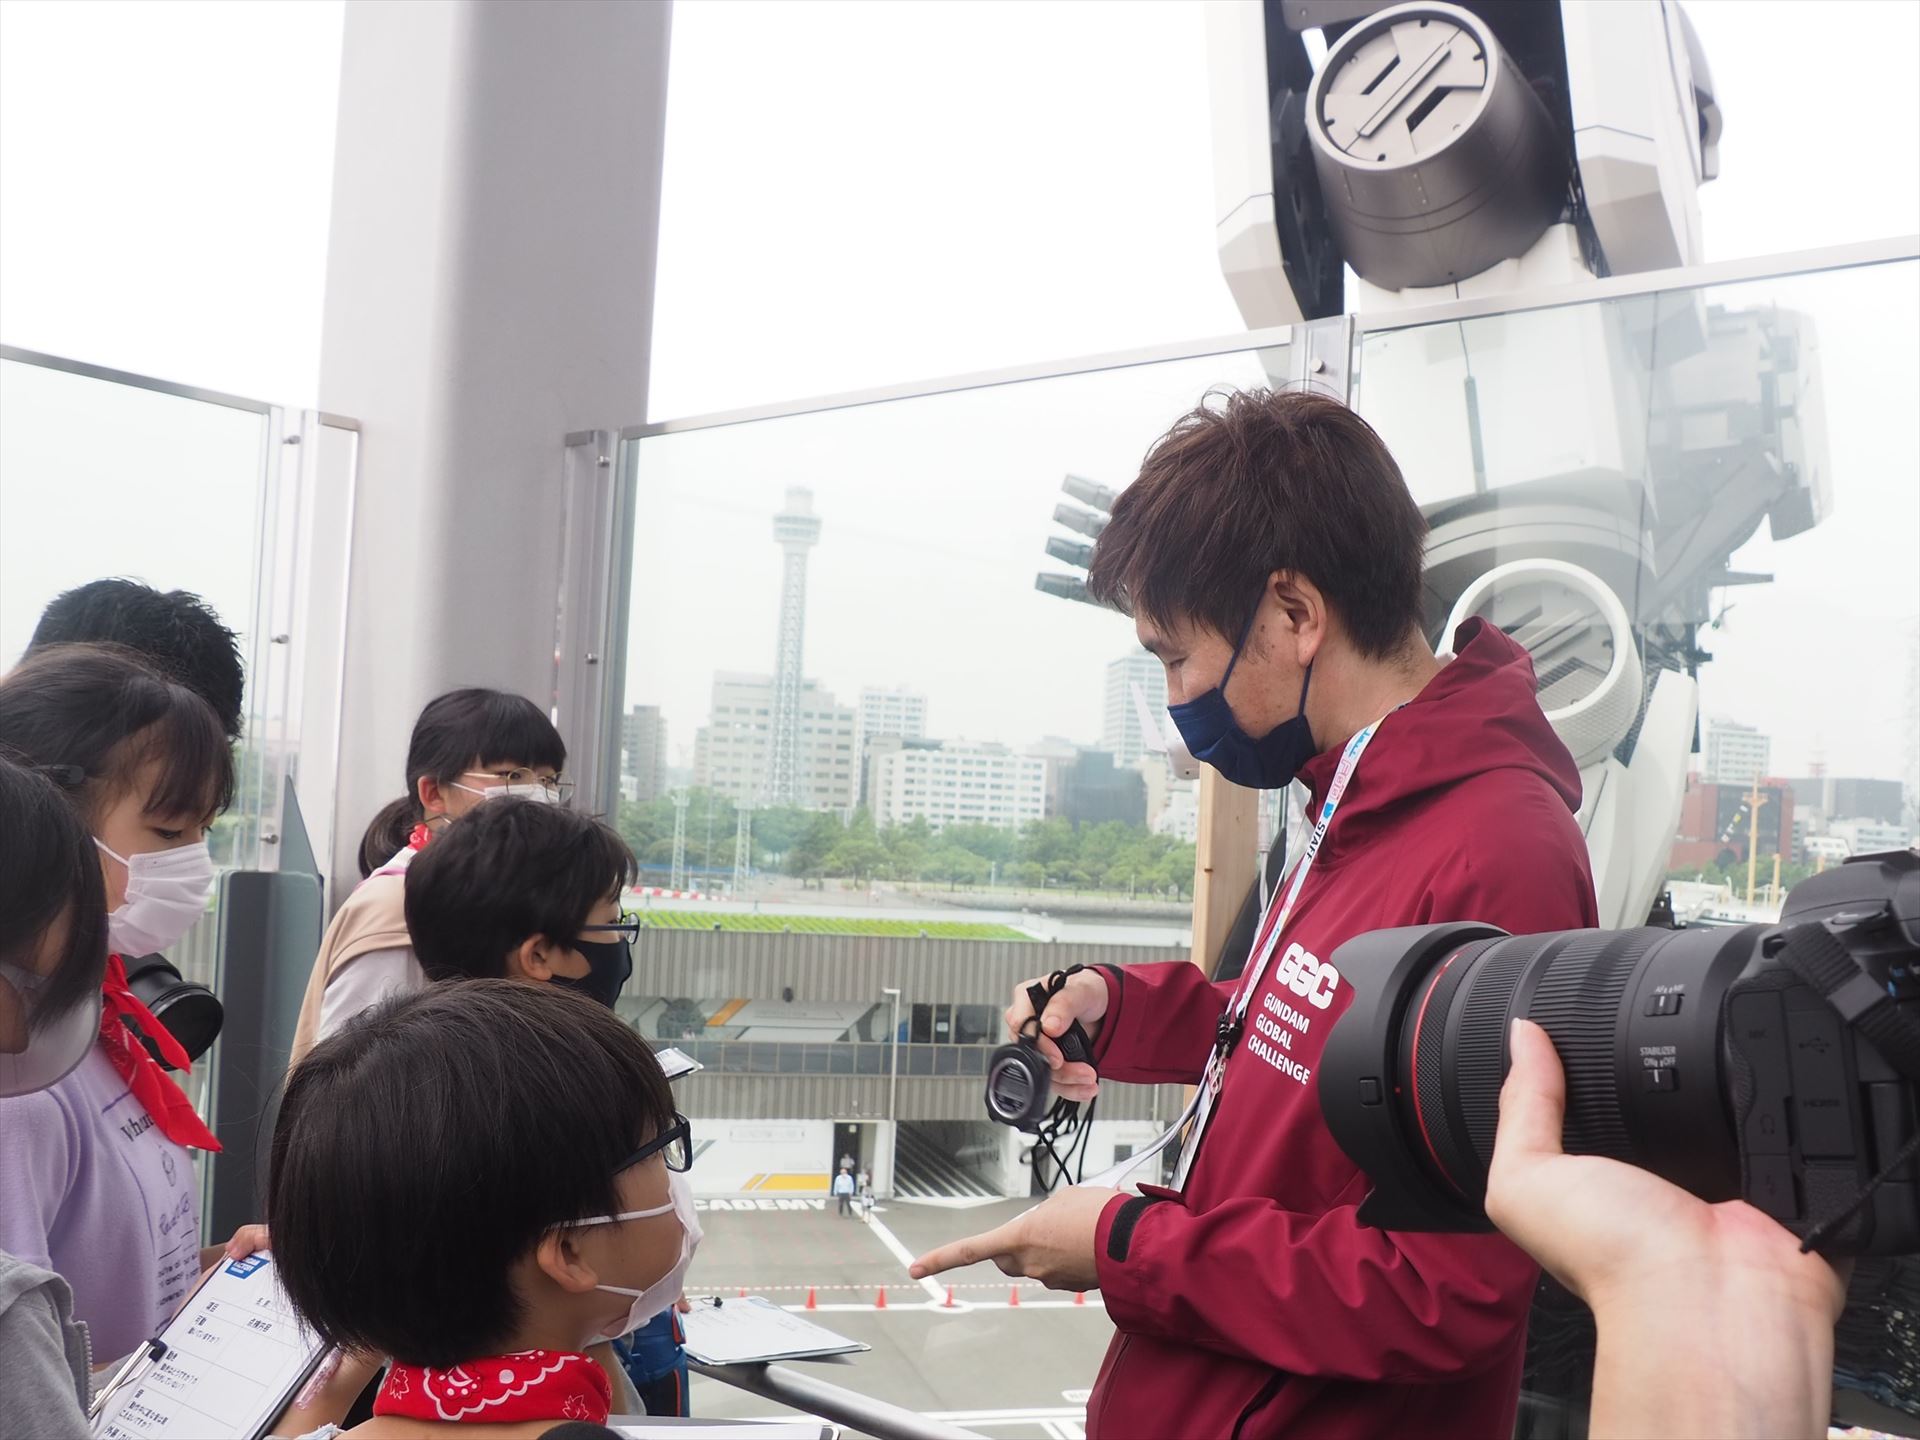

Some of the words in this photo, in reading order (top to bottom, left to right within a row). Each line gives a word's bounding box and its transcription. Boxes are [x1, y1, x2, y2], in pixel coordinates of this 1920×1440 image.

[1307, 821, 1326, 862] STAFF
[1276, 942, 1339, 1010] GGC
[1255, 1013, 1292, 1050] GLOBAL
[1264, 992, 1310, 1034] GUNDAM
[1247, 1034, 1311, 1085] CHALLENGE
[1640, 1046, 1676, 1056] STABILIZER
